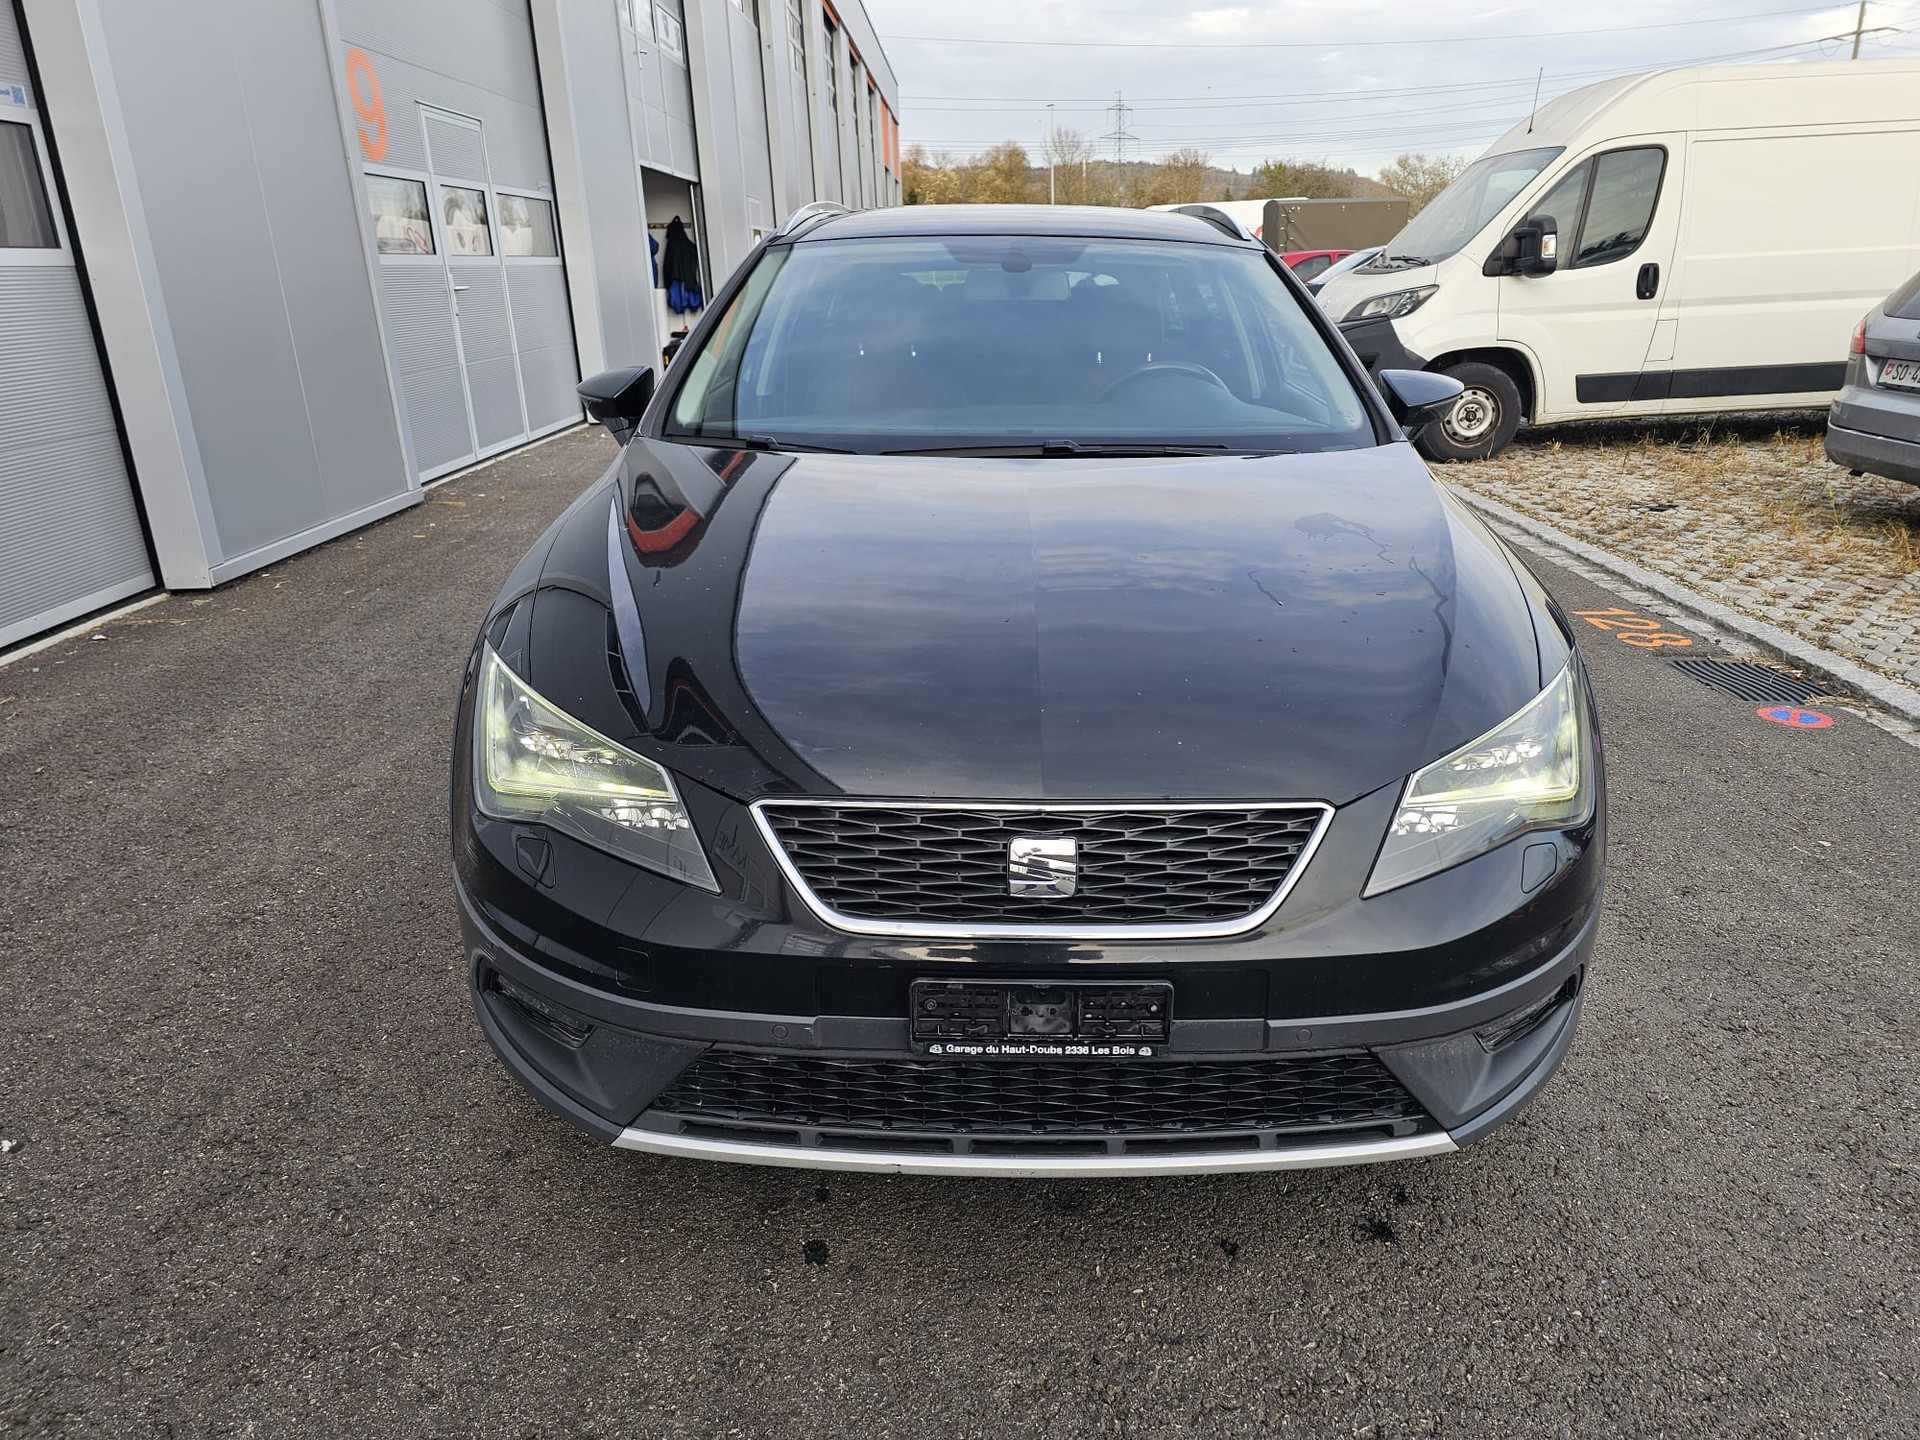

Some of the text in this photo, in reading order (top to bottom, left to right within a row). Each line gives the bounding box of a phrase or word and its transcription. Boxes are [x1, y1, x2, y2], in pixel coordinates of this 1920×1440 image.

[345, 47, 388, 162] 9
[1572, 607, 1693, 647] 128
[946, 1044, 1135, 1055] Garage du Haut-Doubs 2336 Les Bois
